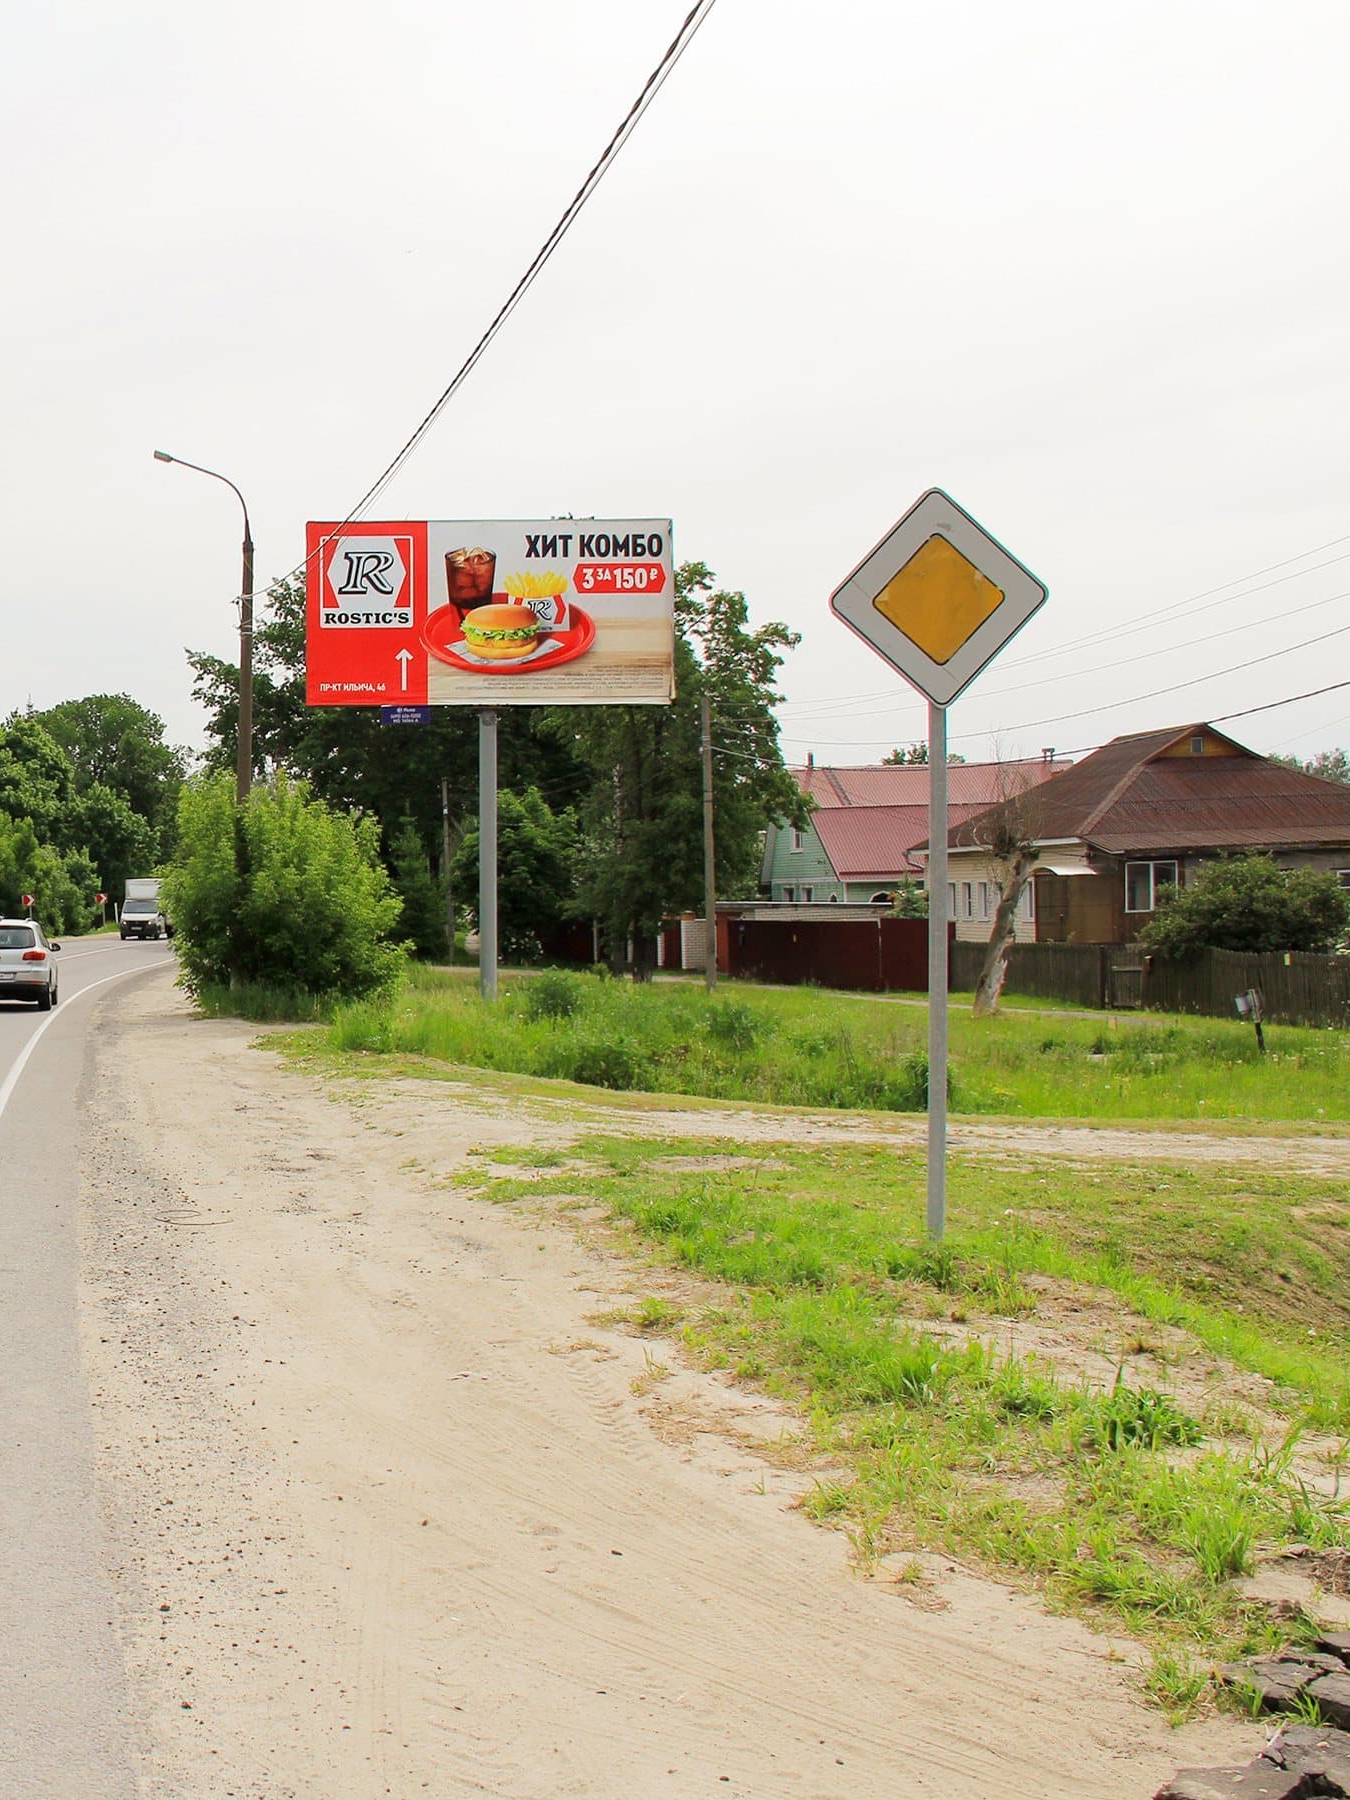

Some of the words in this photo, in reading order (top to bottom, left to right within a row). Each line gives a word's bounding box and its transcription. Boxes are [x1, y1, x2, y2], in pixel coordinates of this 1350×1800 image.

[525, 534, 573, 558] ХИТ
[579, 533, 663, 558] КОМБО
[582, 567, 595, 589] 3
[596, 568, 612, 580] ЗА
[324, 612, 410, 625] ROSTIC'S
[319, 683, 342, 692] ПР-КТ
[343, 683, 376, 693] ИЛЬИЧА,
[376, 683, 386, 692] 46
